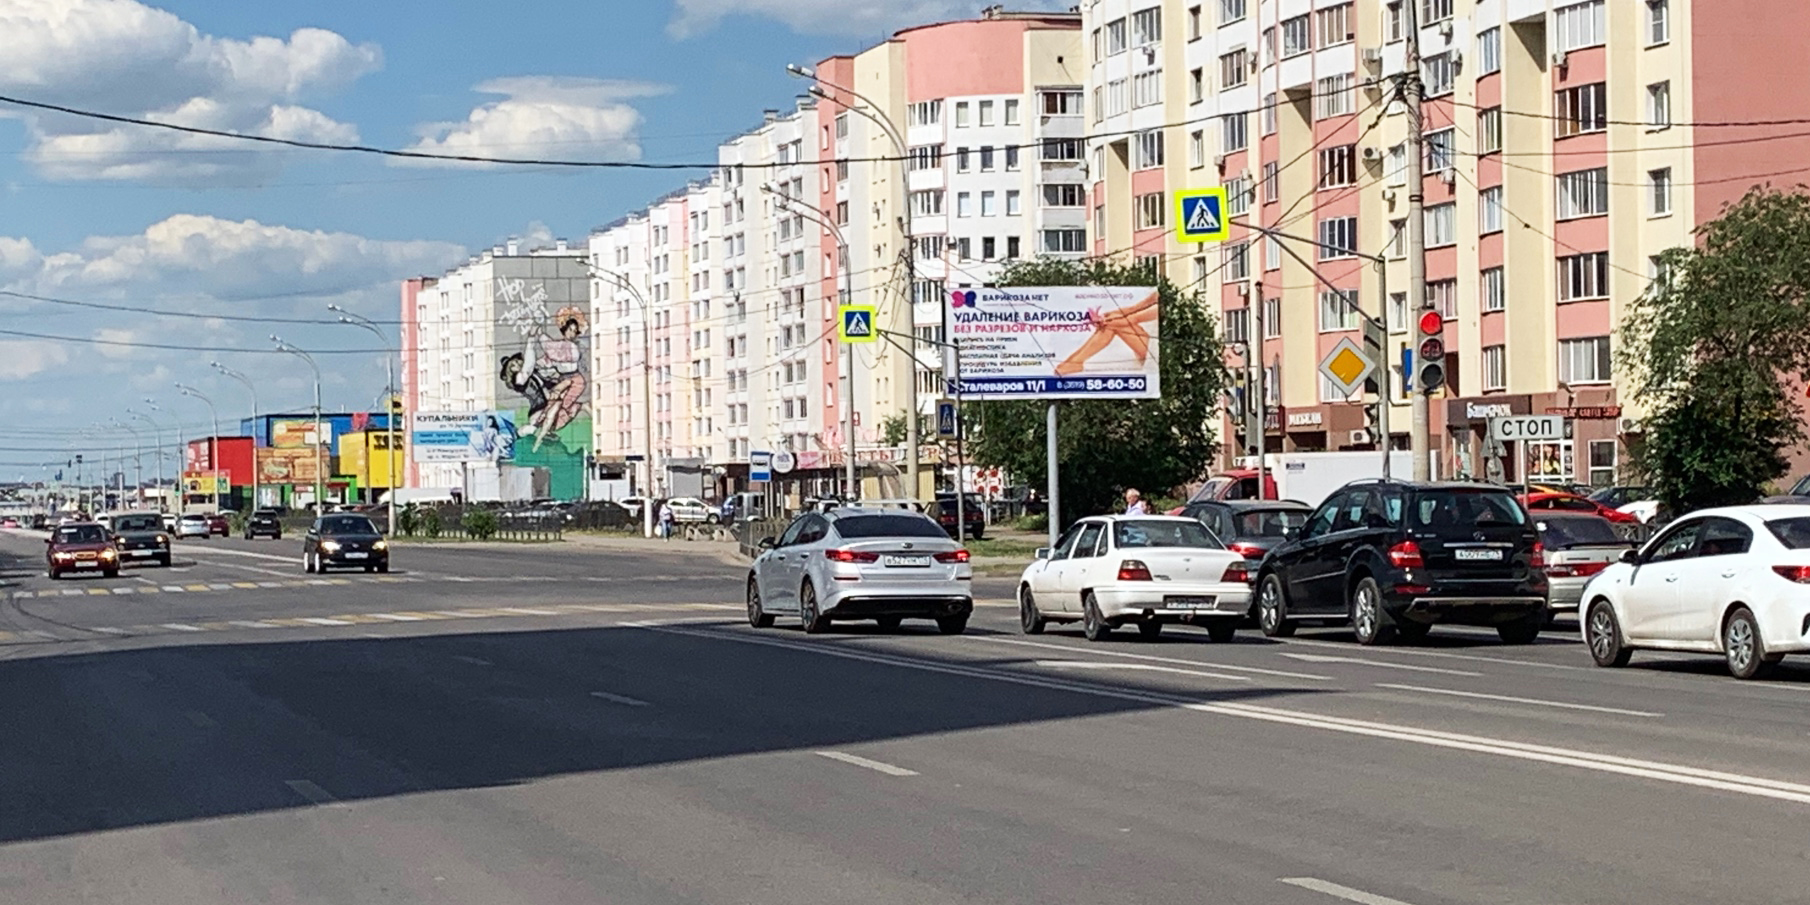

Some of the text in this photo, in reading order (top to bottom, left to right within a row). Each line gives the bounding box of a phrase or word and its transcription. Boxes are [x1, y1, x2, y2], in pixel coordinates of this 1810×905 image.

[954, 311, 1092, 323] УДАЛЕНИЕ ВАРИКОЗА
[954, 323, 1092, 333] БЕЗ РАЗРЕЗОВ И НАРКОЗА
[1026, 381, 1047, 393] 11/1
[1086, 379, 1146, 390] 58-60-50
[416, 414, 479, 423] КУПАЛЬНИКИ
[1501, 418, 1553, 437] СТОП
